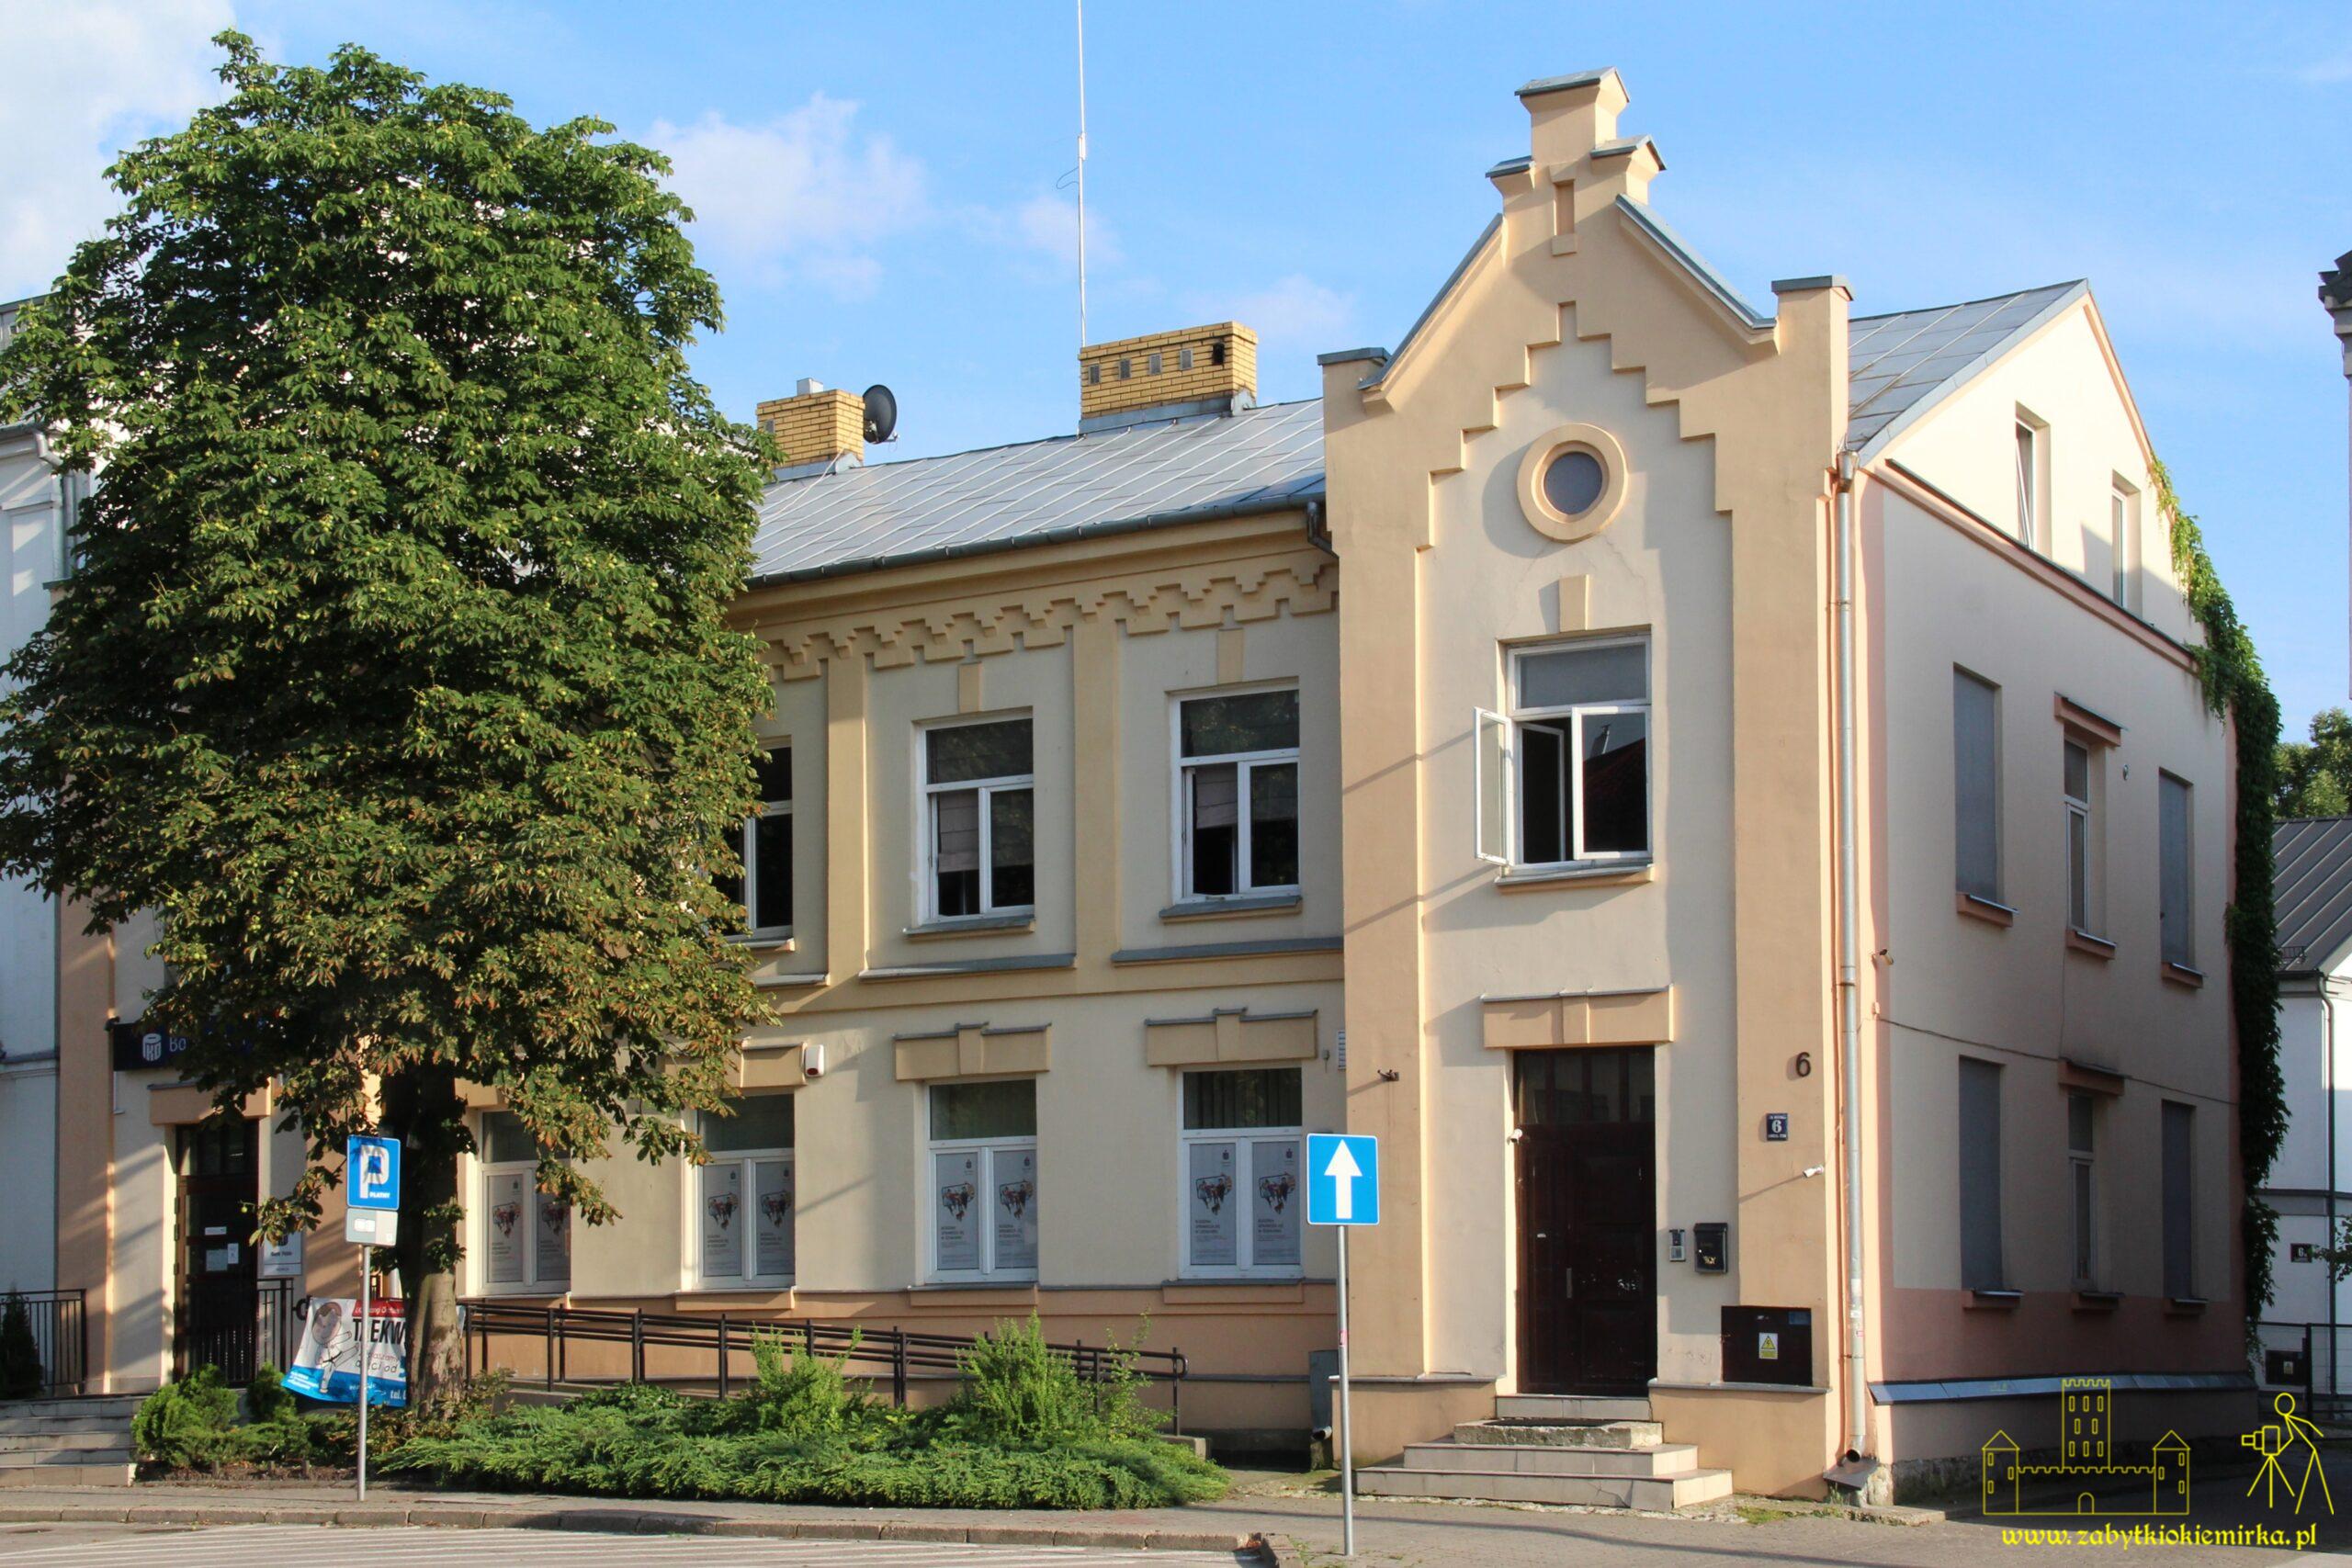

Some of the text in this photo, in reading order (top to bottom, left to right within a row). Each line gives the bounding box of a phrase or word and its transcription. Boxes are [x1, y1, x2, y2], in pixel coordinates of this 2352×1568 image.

[1795, 1051, 1811, 1077] 6
[1771, 1120, 1782, 1134] 6
[359, 1145, 390, 1199] P
[353, 1318, 406, 1344] TEKW
